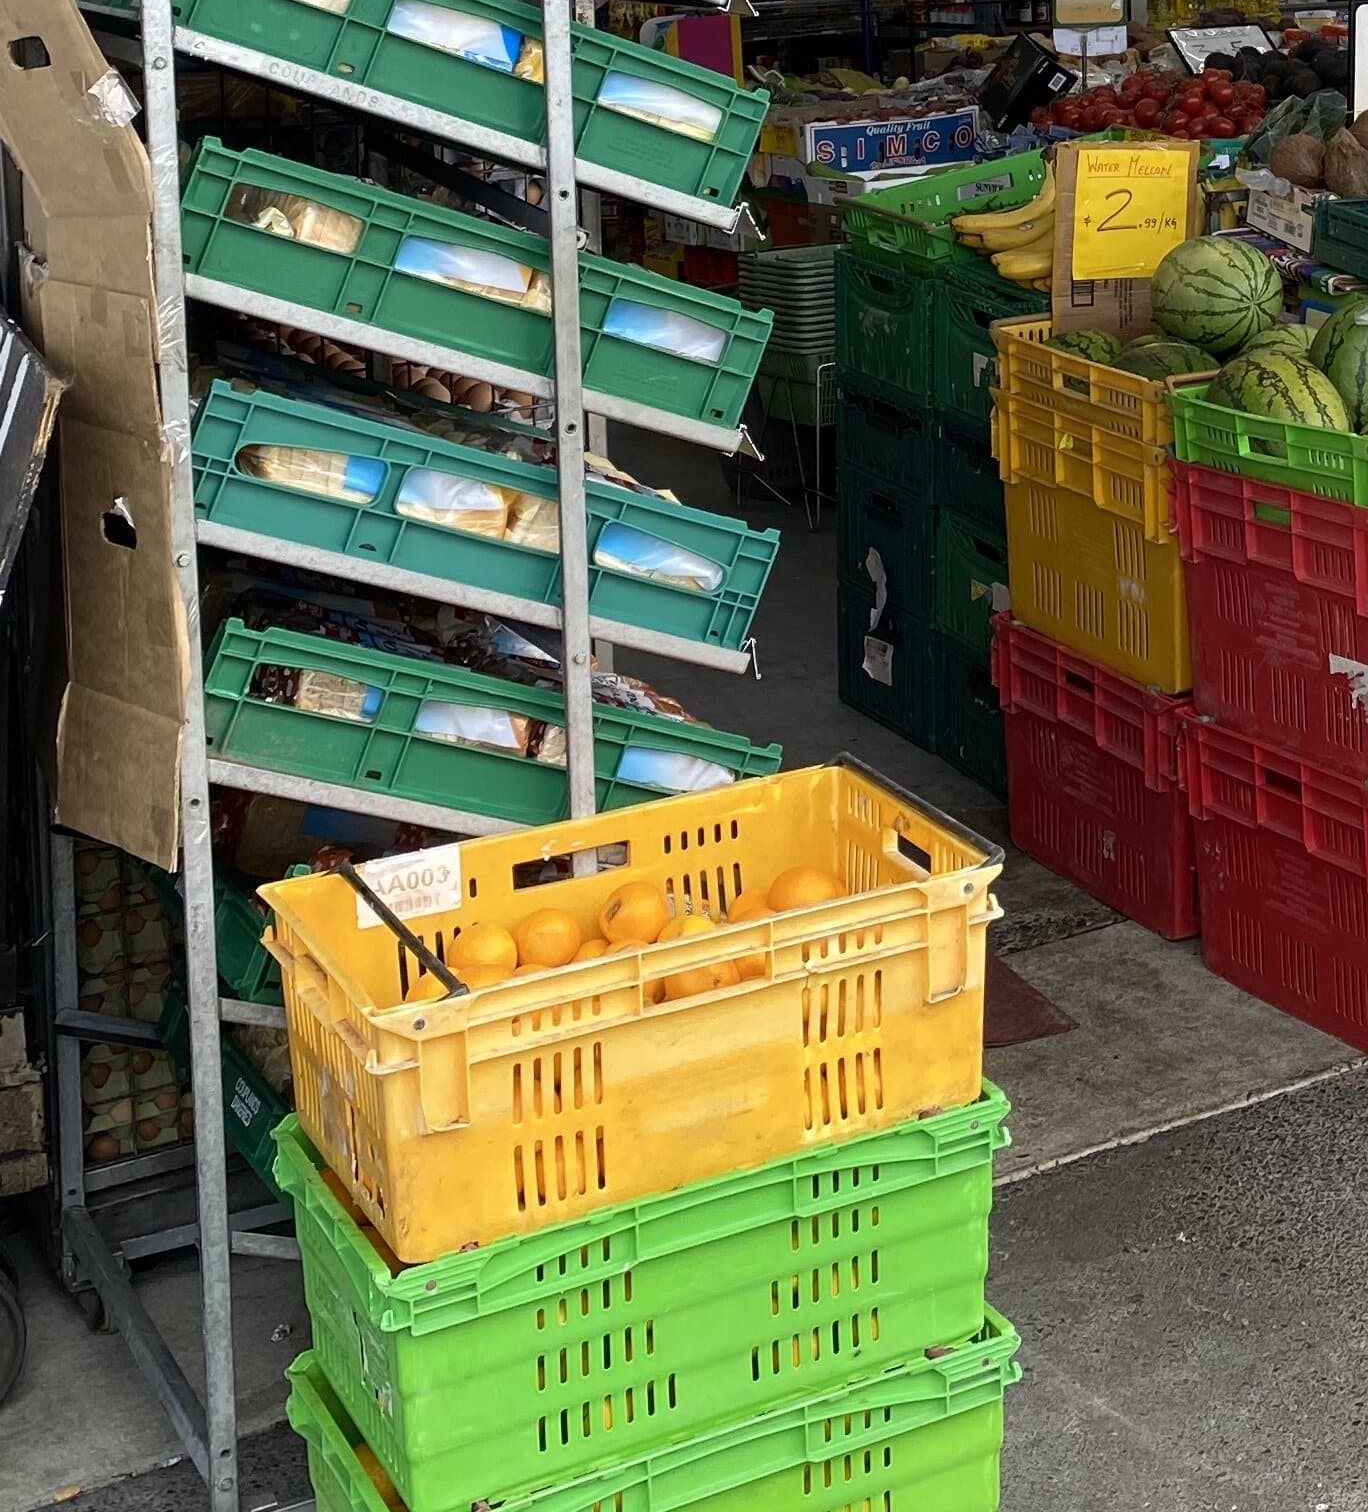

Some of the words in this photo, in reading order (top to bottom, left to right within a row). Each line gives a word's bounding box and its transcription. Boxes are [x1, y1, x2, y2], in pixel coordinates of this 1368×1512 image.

[865, 123, 904, 137] Quality
[905, 120, 932, 133] Fruit
[1086, 153, 1121, 174] WATER
